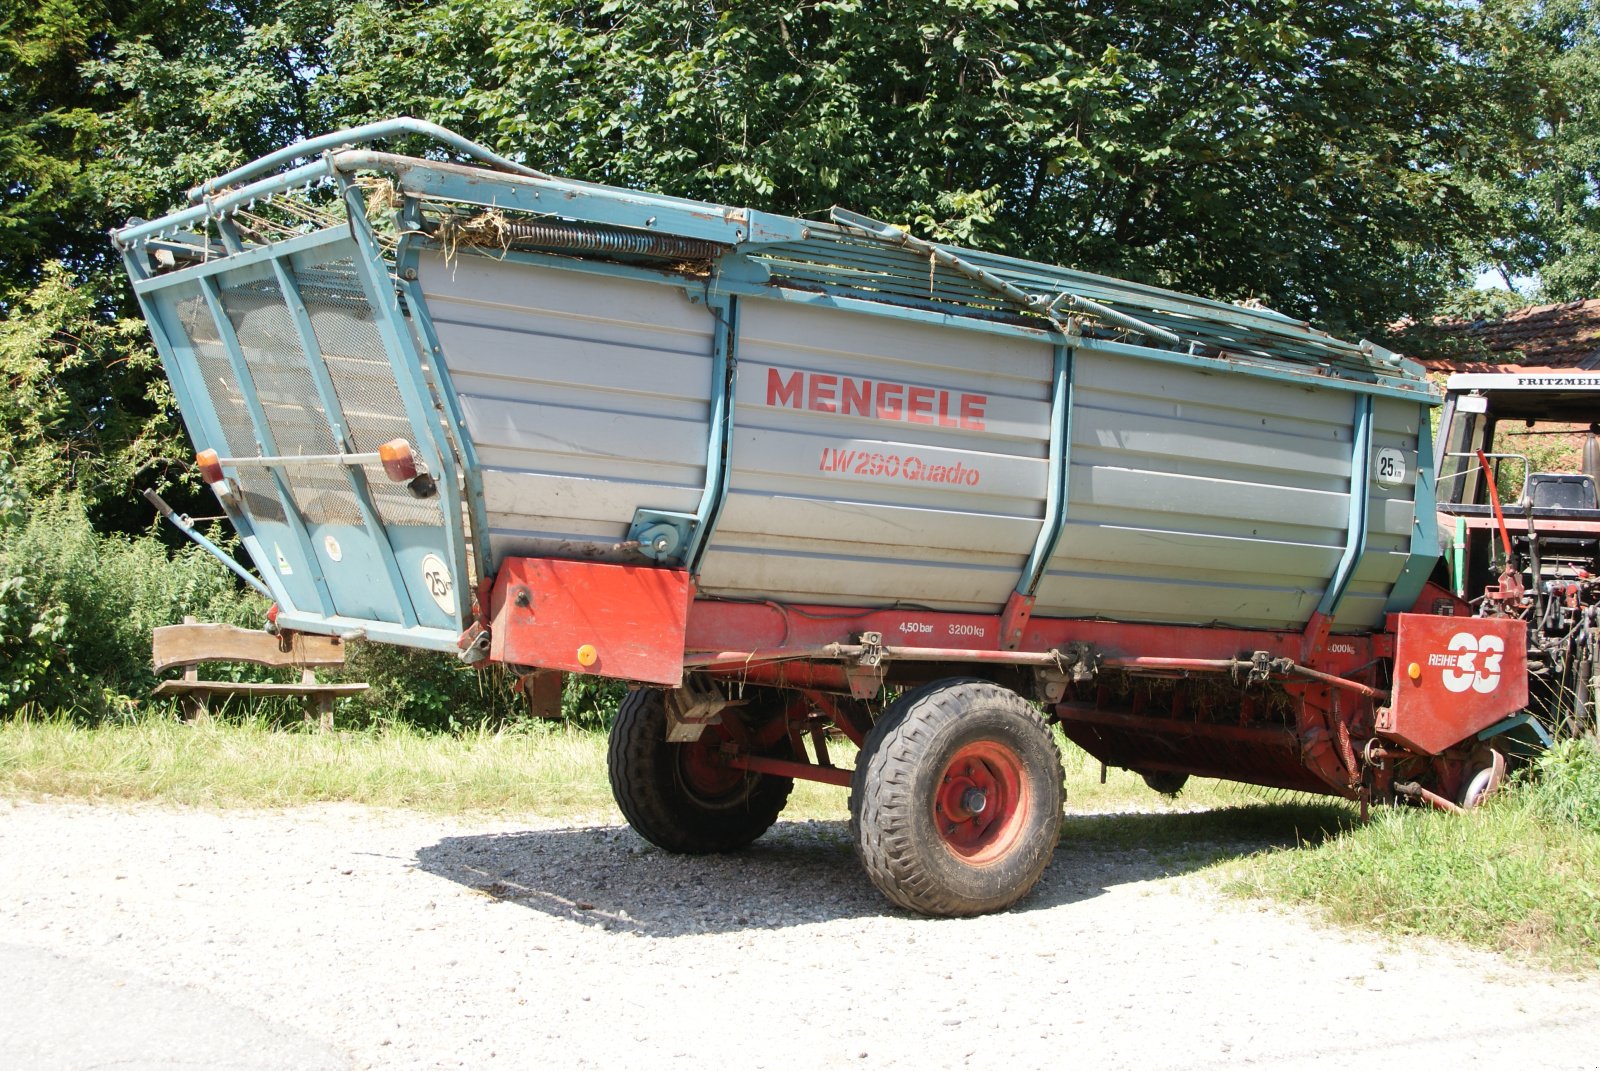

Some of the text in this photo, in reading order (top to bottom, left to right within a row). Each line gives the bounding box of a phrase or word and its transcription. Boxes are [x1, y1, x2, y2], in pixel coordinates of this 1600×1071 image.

[766, 367, 988, 431] MENGELE
[819, 447, 980, 486] LW 290 Quadro
[1380, 456, 1394, 477] 25
[425, 571, 447, 596] 25
[1428, 632, 1505, 694] REIHE 33
